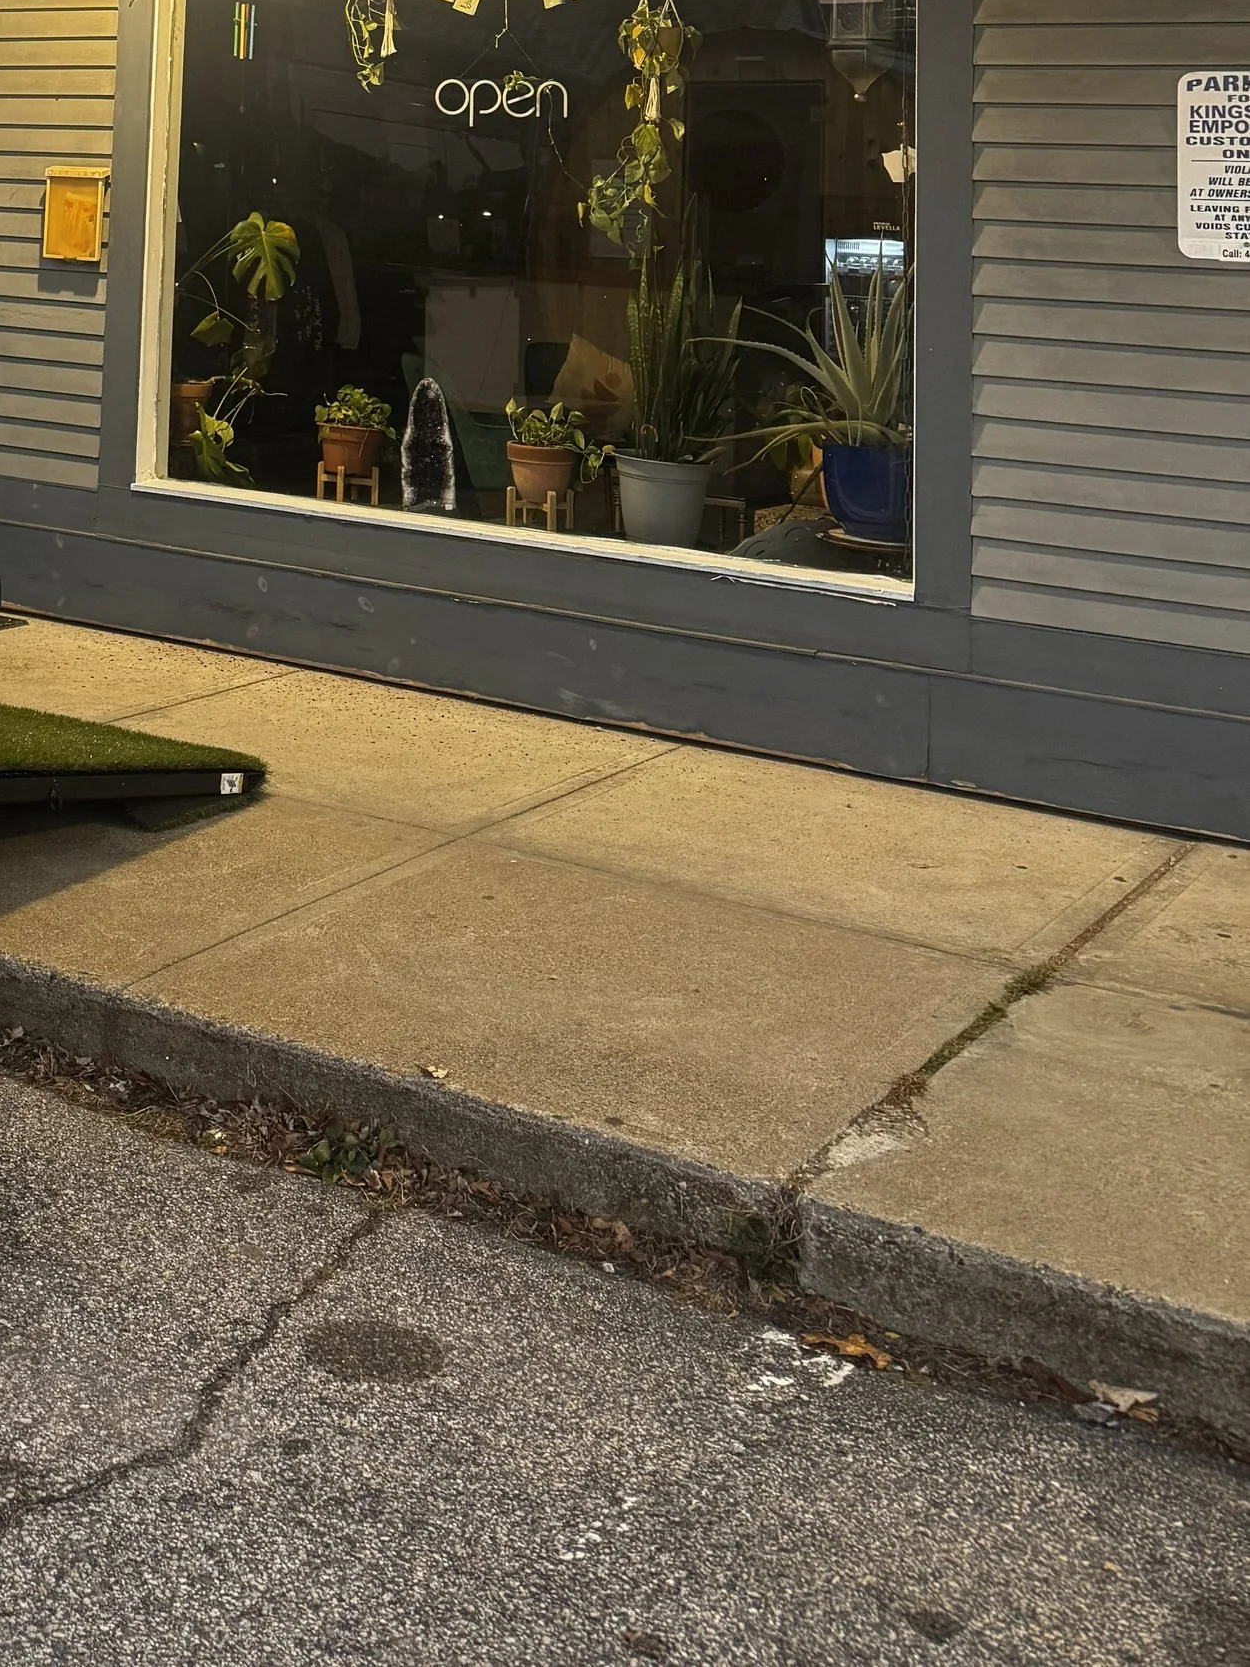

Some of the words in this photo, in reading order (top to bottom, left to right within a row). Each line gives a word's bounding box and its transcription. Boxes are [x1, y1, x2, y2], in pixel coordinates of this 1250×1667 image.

[435, 78, 568, 127] open
[1224, 165, 1250, 175] VIOL
[1208, 176, 1234, 186] WILL
[1189, 188, 1205, 197] AT
[1190, 204, 1240, 213] LEAVING
[1195, 222, 1231, 230] VOIDS
[1225, 232, 1250, 240] STA
